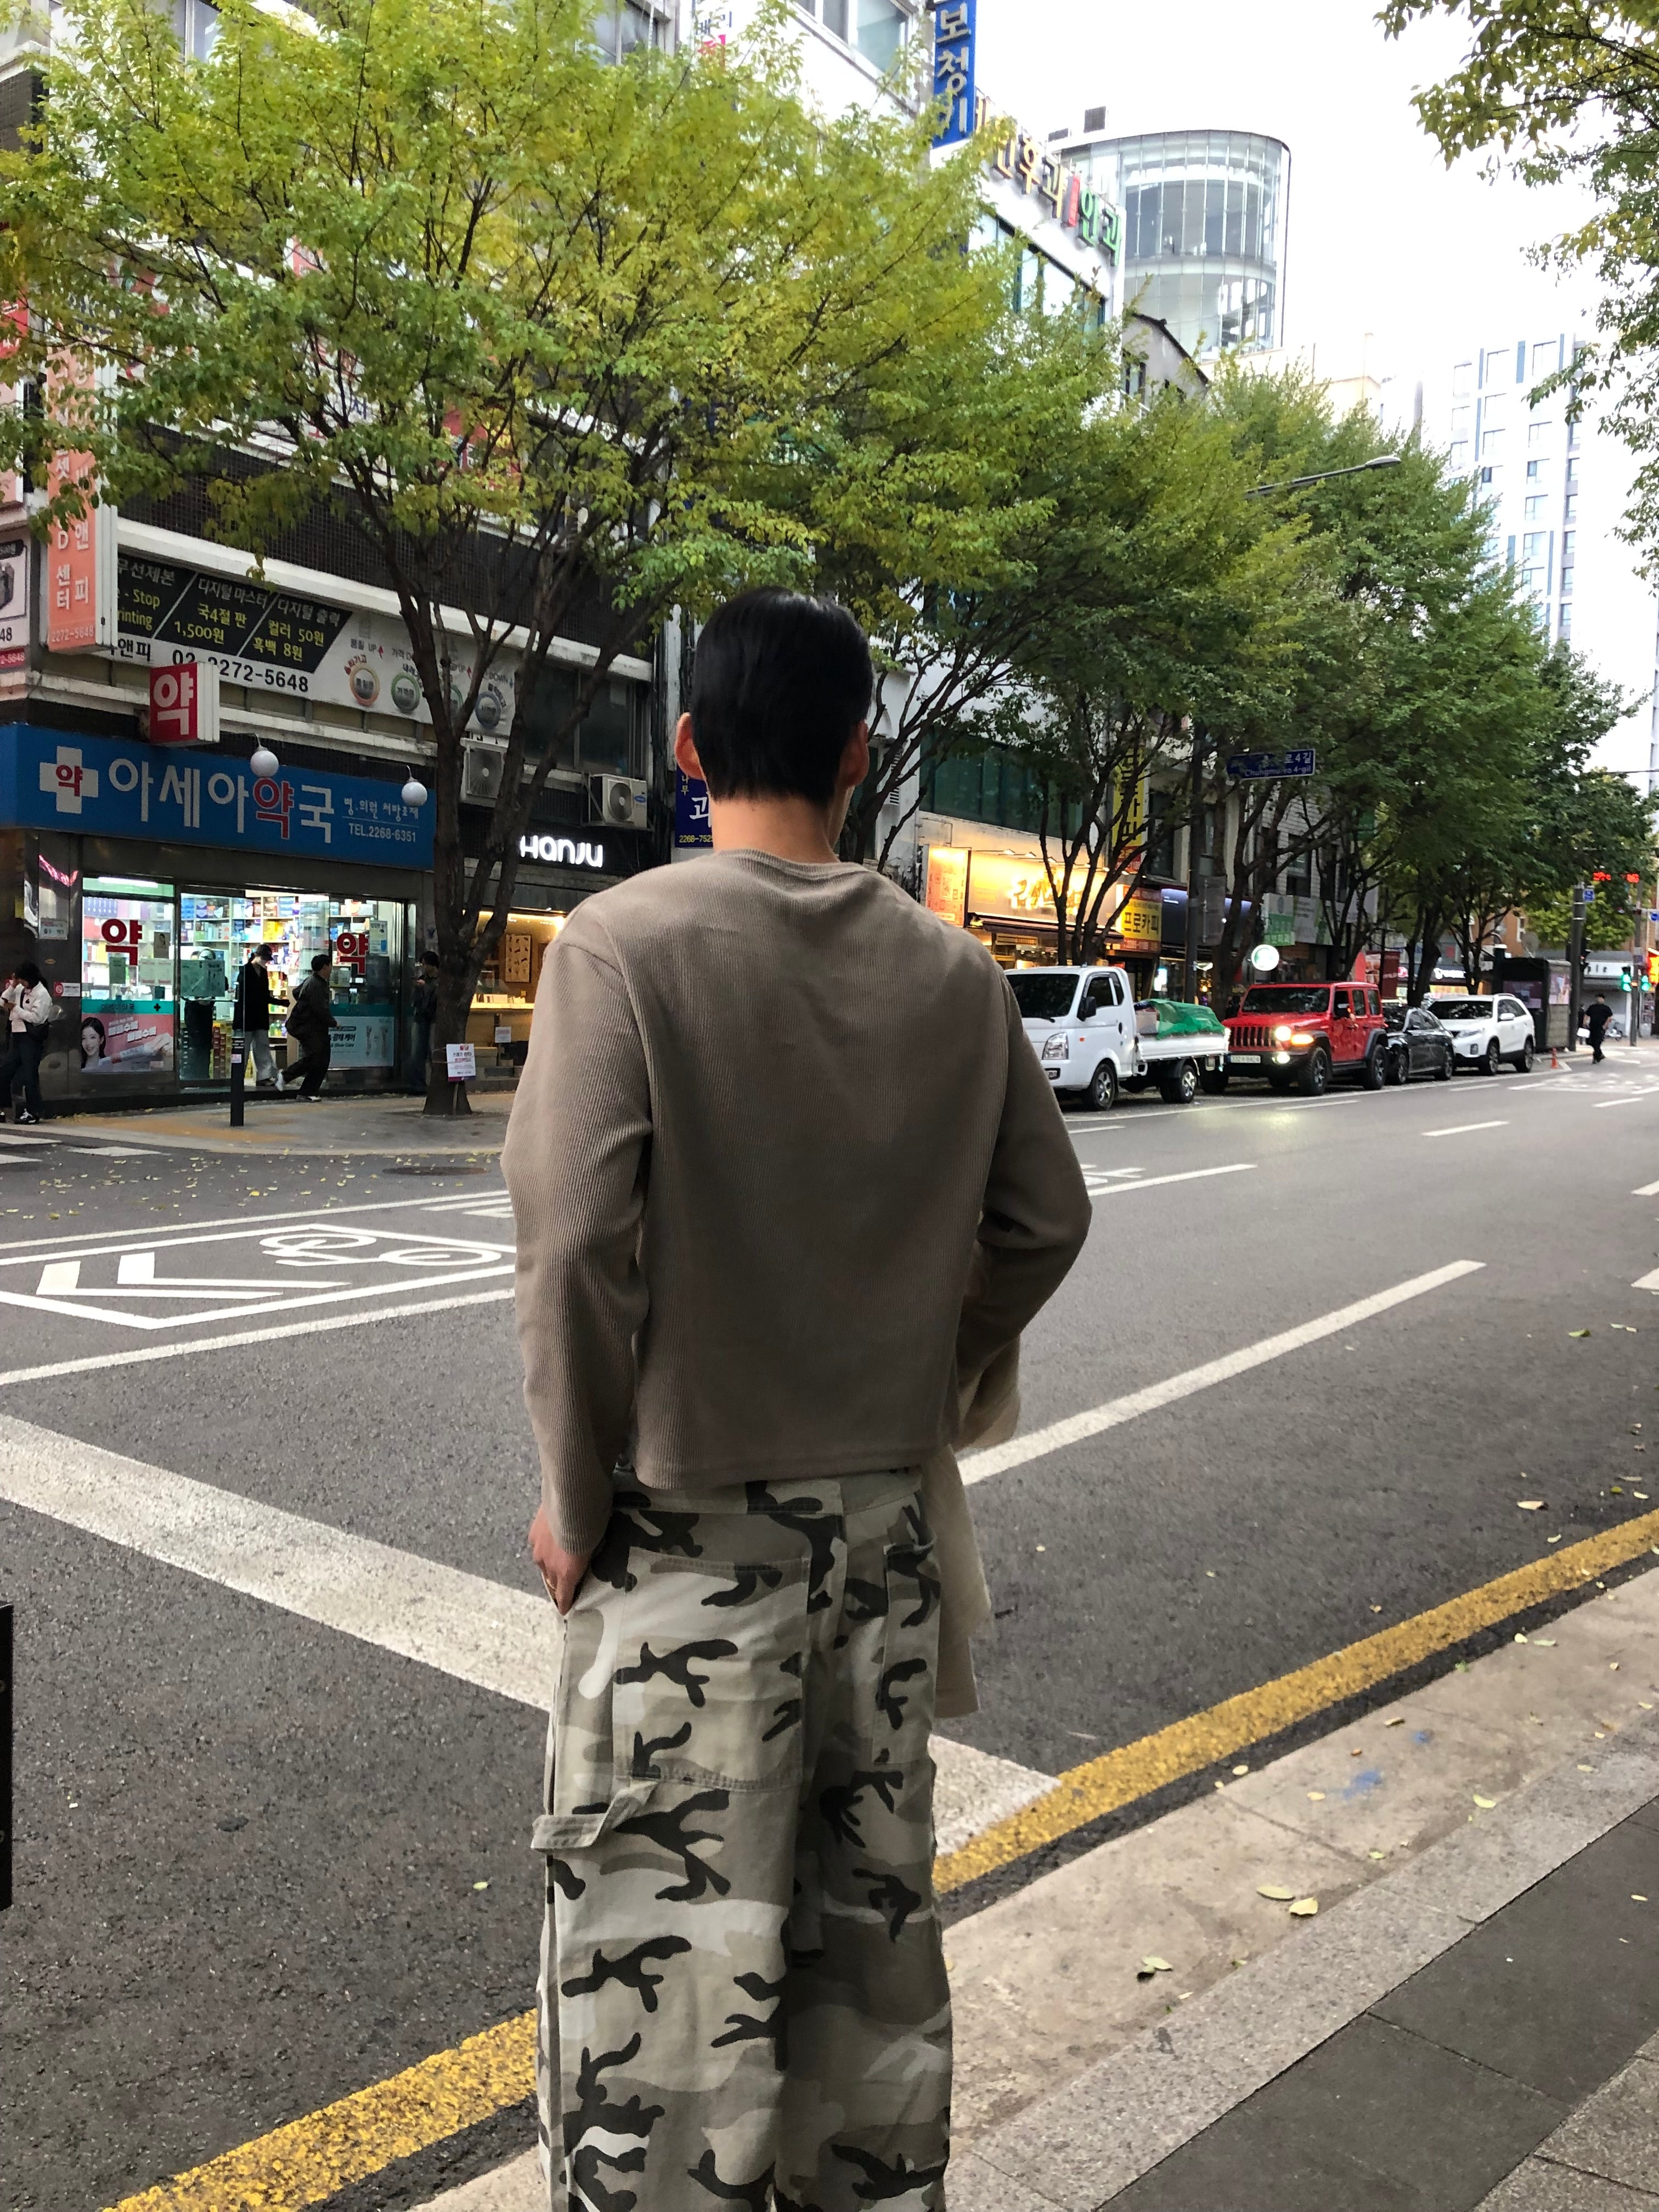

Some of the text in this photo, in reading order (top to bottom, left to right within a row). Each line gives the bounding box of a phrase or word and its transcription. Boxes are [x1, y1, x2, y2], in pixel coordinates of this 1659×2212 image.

[1079, 187, 1122, 267] 안과
[133, 588, 160, 610] Stop
[278, 598, 313, 620] 디지털
[117, 606, 153, 631] rinting
[52, 625, 94, 642] 2272-5648
[174, 620, 224, 645] 1,500원
[268, 619, 324, 647] 컬러 50원
[253, 636, 302, 662] 흑백 8원
[154, 672, 194, 735] 약
[56, 765, 83, 797] 약
[1245, 768, 1291, 777] Chungmuro
[109, 758, 335, 844] 아세아약국
[348, 822, 416, 843] TEL.2268-6351
[679, 834, 713, 843] 2268-752
[1124, 912, 1159, 935] 프로카피
[101, 918, 143, 966] 약
[336, 933, 369, 975] 약
